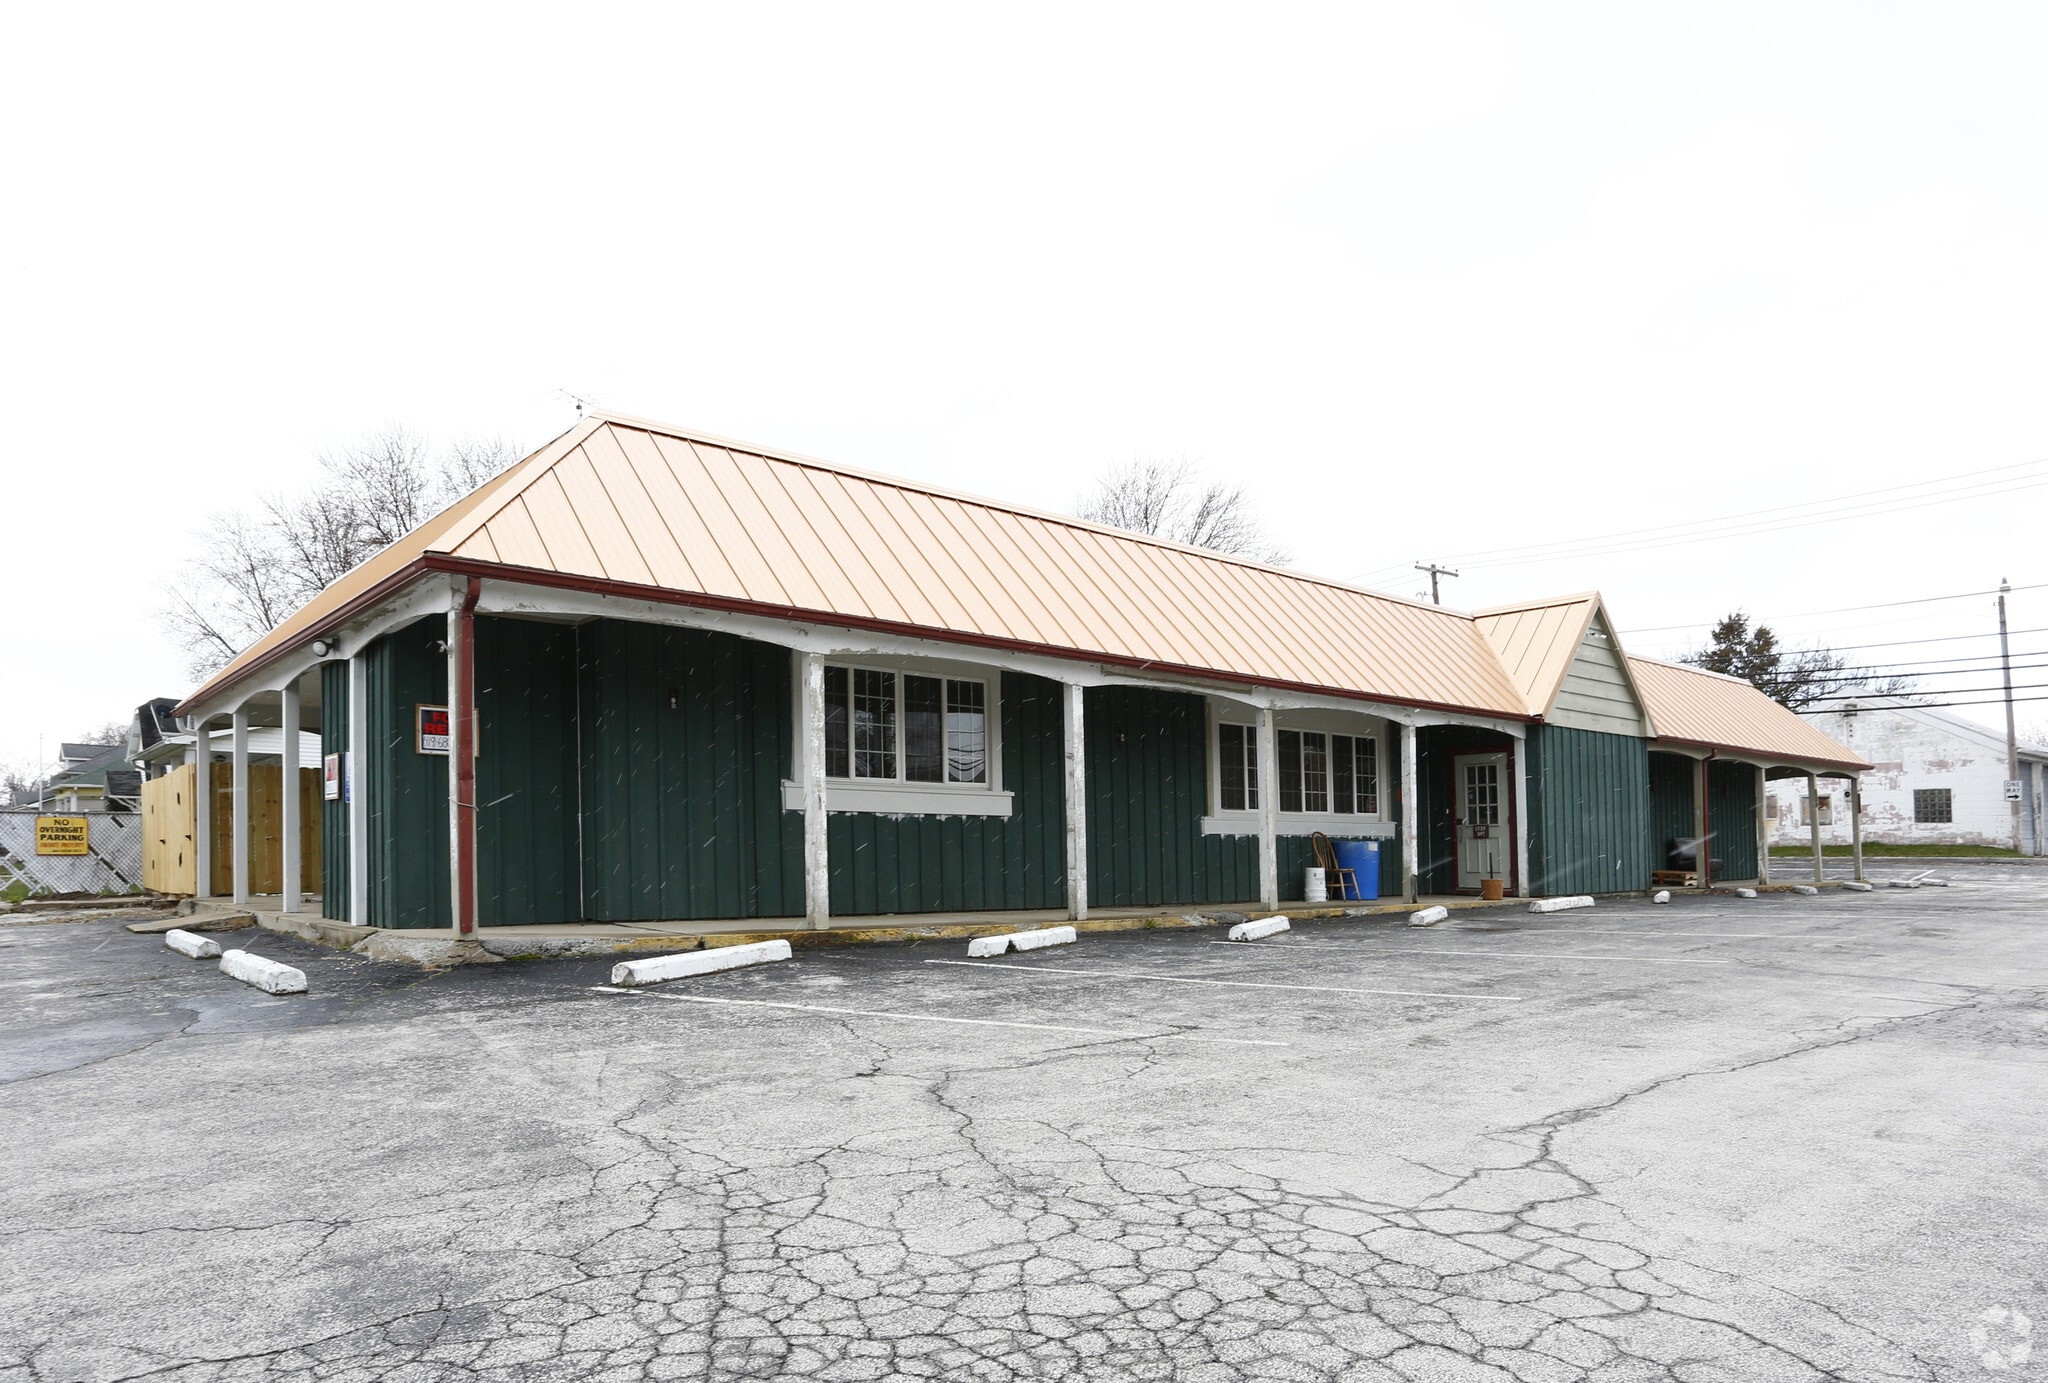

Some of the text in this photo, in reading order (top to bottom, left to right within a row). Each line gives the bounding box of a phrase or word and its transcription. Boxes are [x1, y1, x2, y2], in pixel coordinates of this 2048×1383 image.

[433, 711, 448, 722] FO
[425, 722, 448, 735] RE
[39, 826, 84, 834] OVERNIGHT
